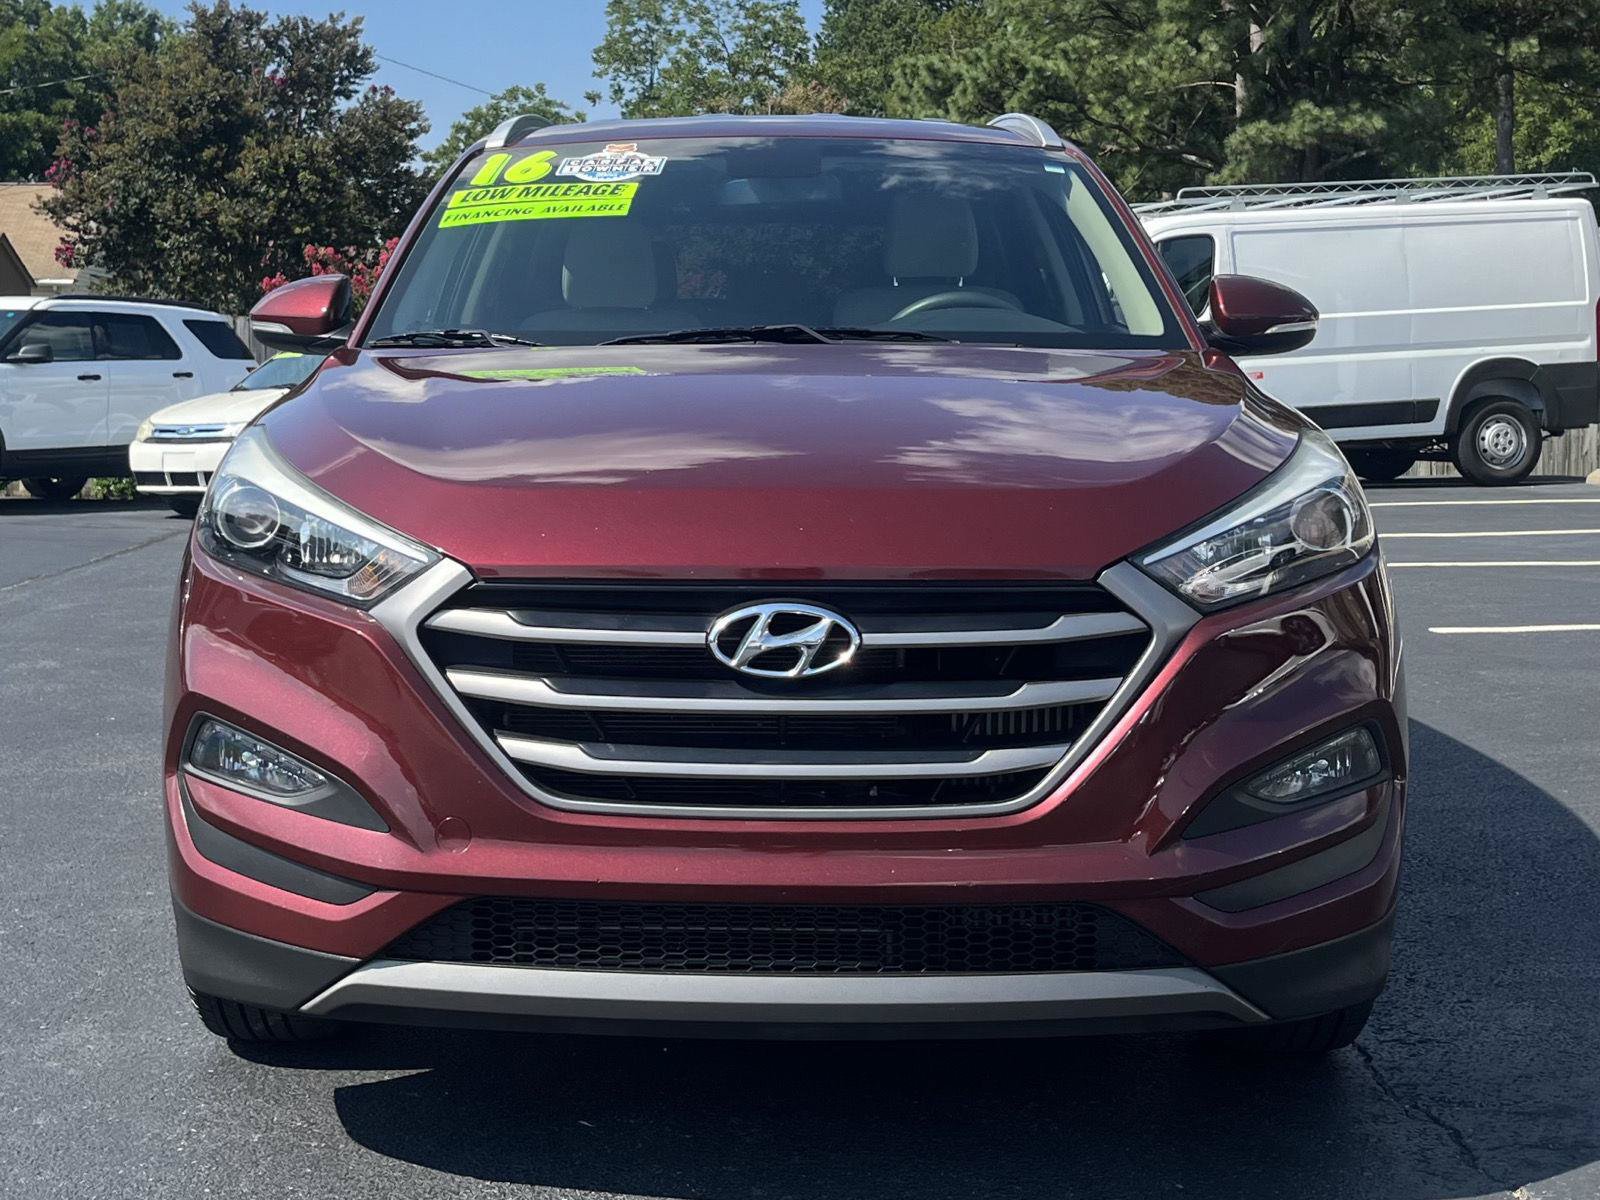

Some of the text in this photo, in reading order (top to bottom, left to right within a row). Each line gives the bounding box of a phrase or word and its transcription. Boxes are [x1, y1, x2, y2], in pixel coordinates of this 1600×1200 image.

[470, 150, 558, 186] 16
[460, 184, 628, 203] LOW MILEAGE
[443, 203, 628, 223] FINANCING AVAILABLE
